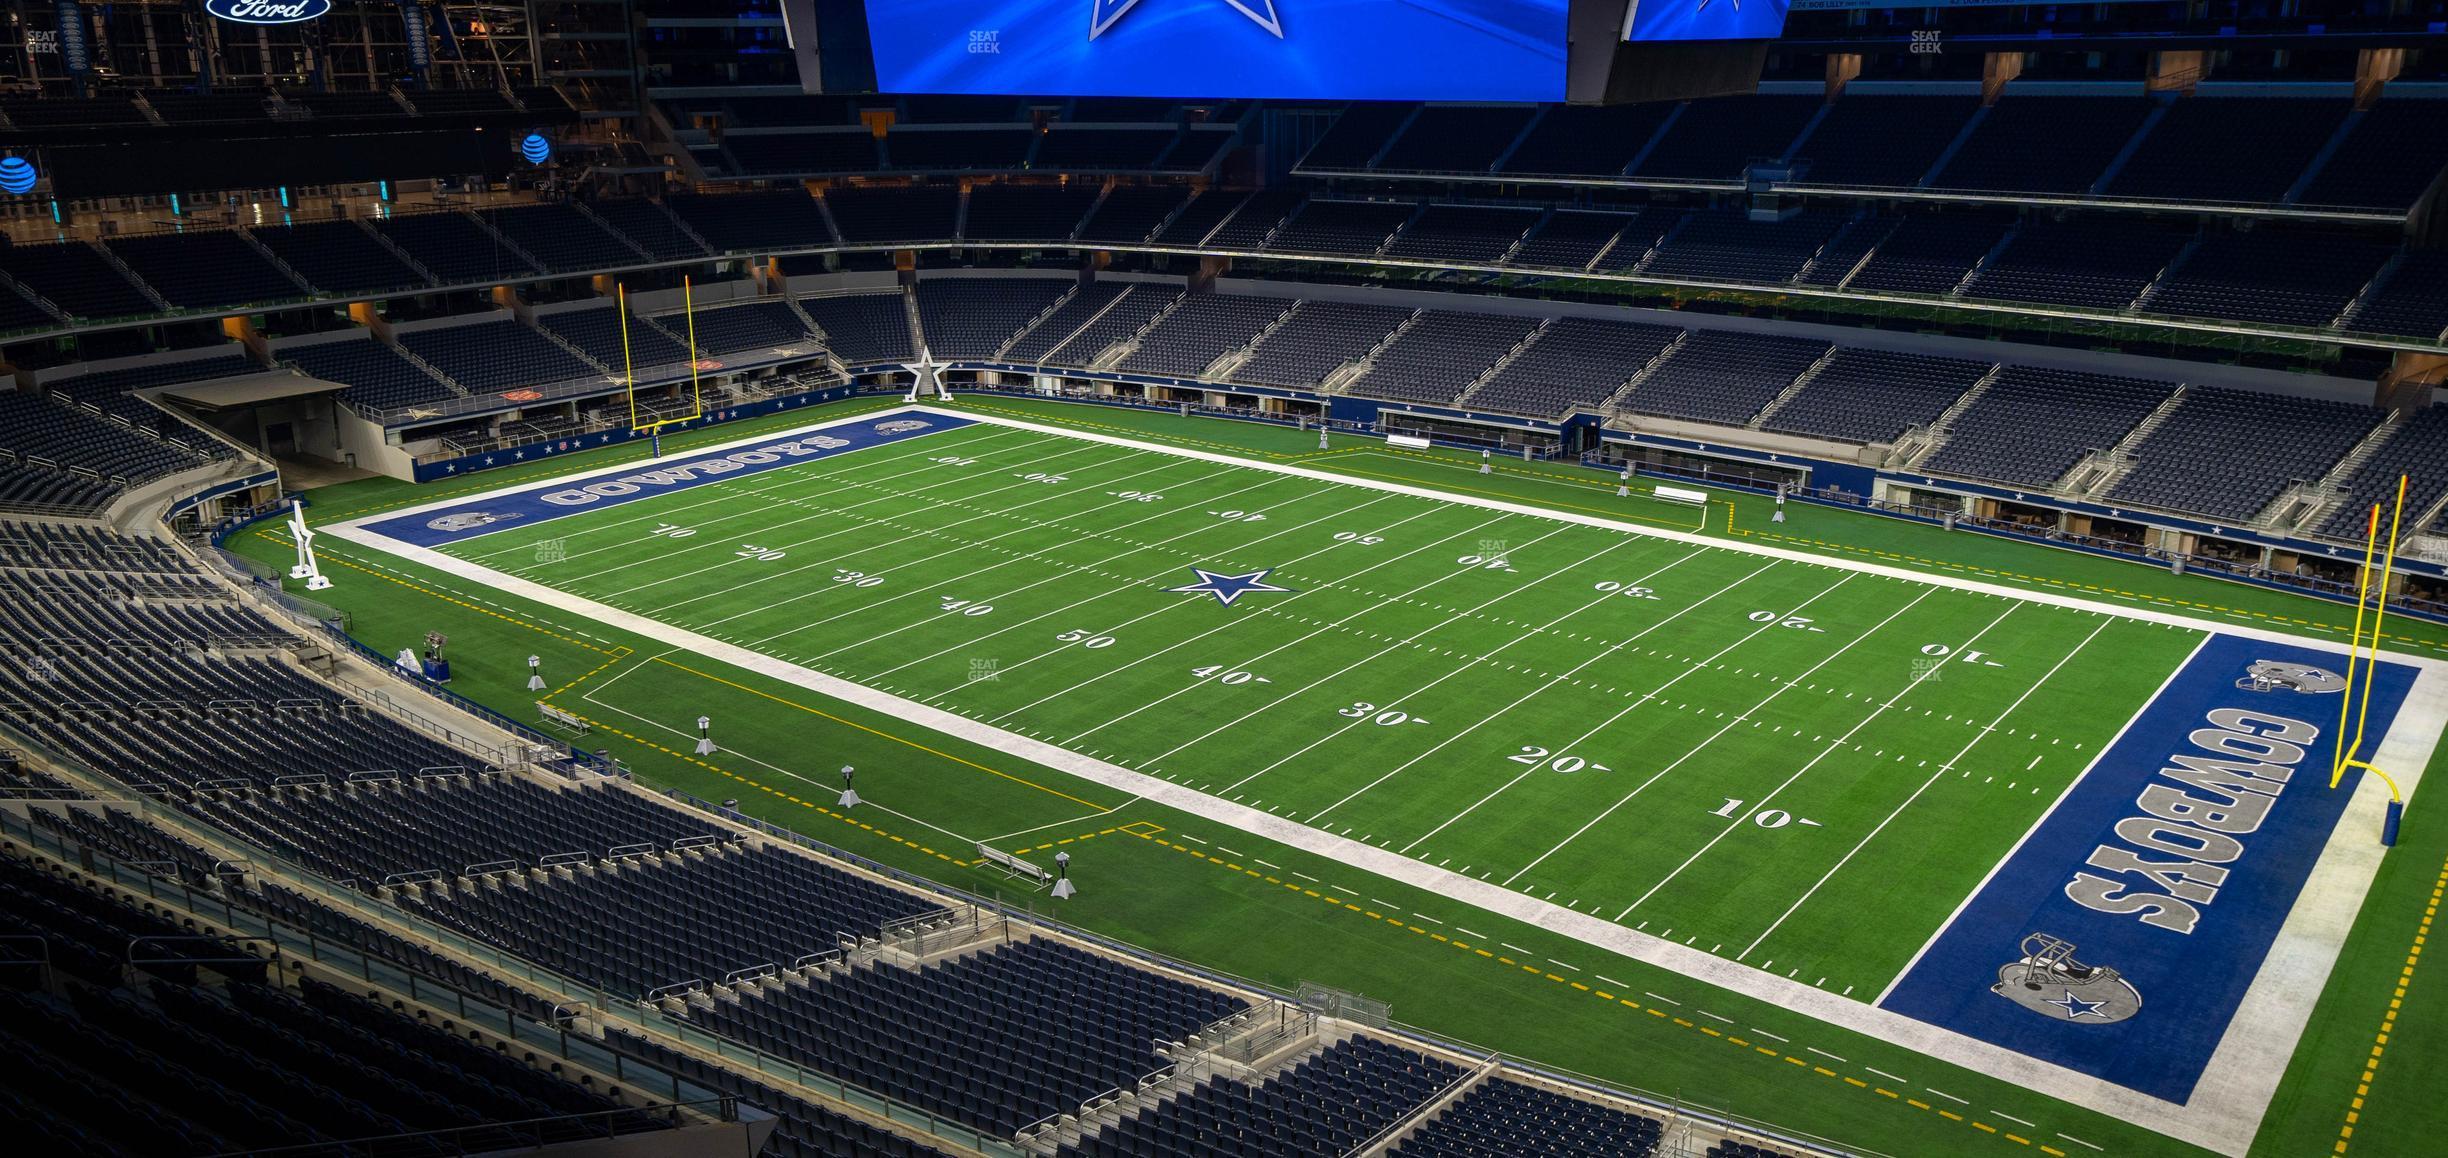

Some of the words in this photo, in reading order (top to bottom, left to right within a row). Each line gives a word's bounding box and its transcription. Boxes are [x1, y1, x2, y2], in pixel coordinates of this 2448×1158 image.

[230, 0, 305, 18] Ford
[937, 456, 978, 466] 10
[540, 435, 850, 506] COWBOYS
[1024, 473, 1070, 484] 20
[1117, 490, 1164, 502] 30
[1220, 510, 1267, 522] 40
[650, 525, 697, 539] 10
[1333, 531, 1385, 546] 50
[735, 546, 787, 561] 20
[1457, 555, 1510, 569] 40
[832, 571, 885, 588] 30
[1594, 581, 1654, 598] 30
[940, 600, 994, 617] 40
[1748, 611, 1815, 629] 20
[1056, 628, 1116, 649] 50
[1920, 644, 1990, 664] 10
[1191, 665, 1253, 685] 40
[1338, 702, 1408, 727] 30
[1507, 745, 1586, 773] 20
[1707, 797, 1792, 828] 10
[2064, 708, 2320, 935] COWBOYS
